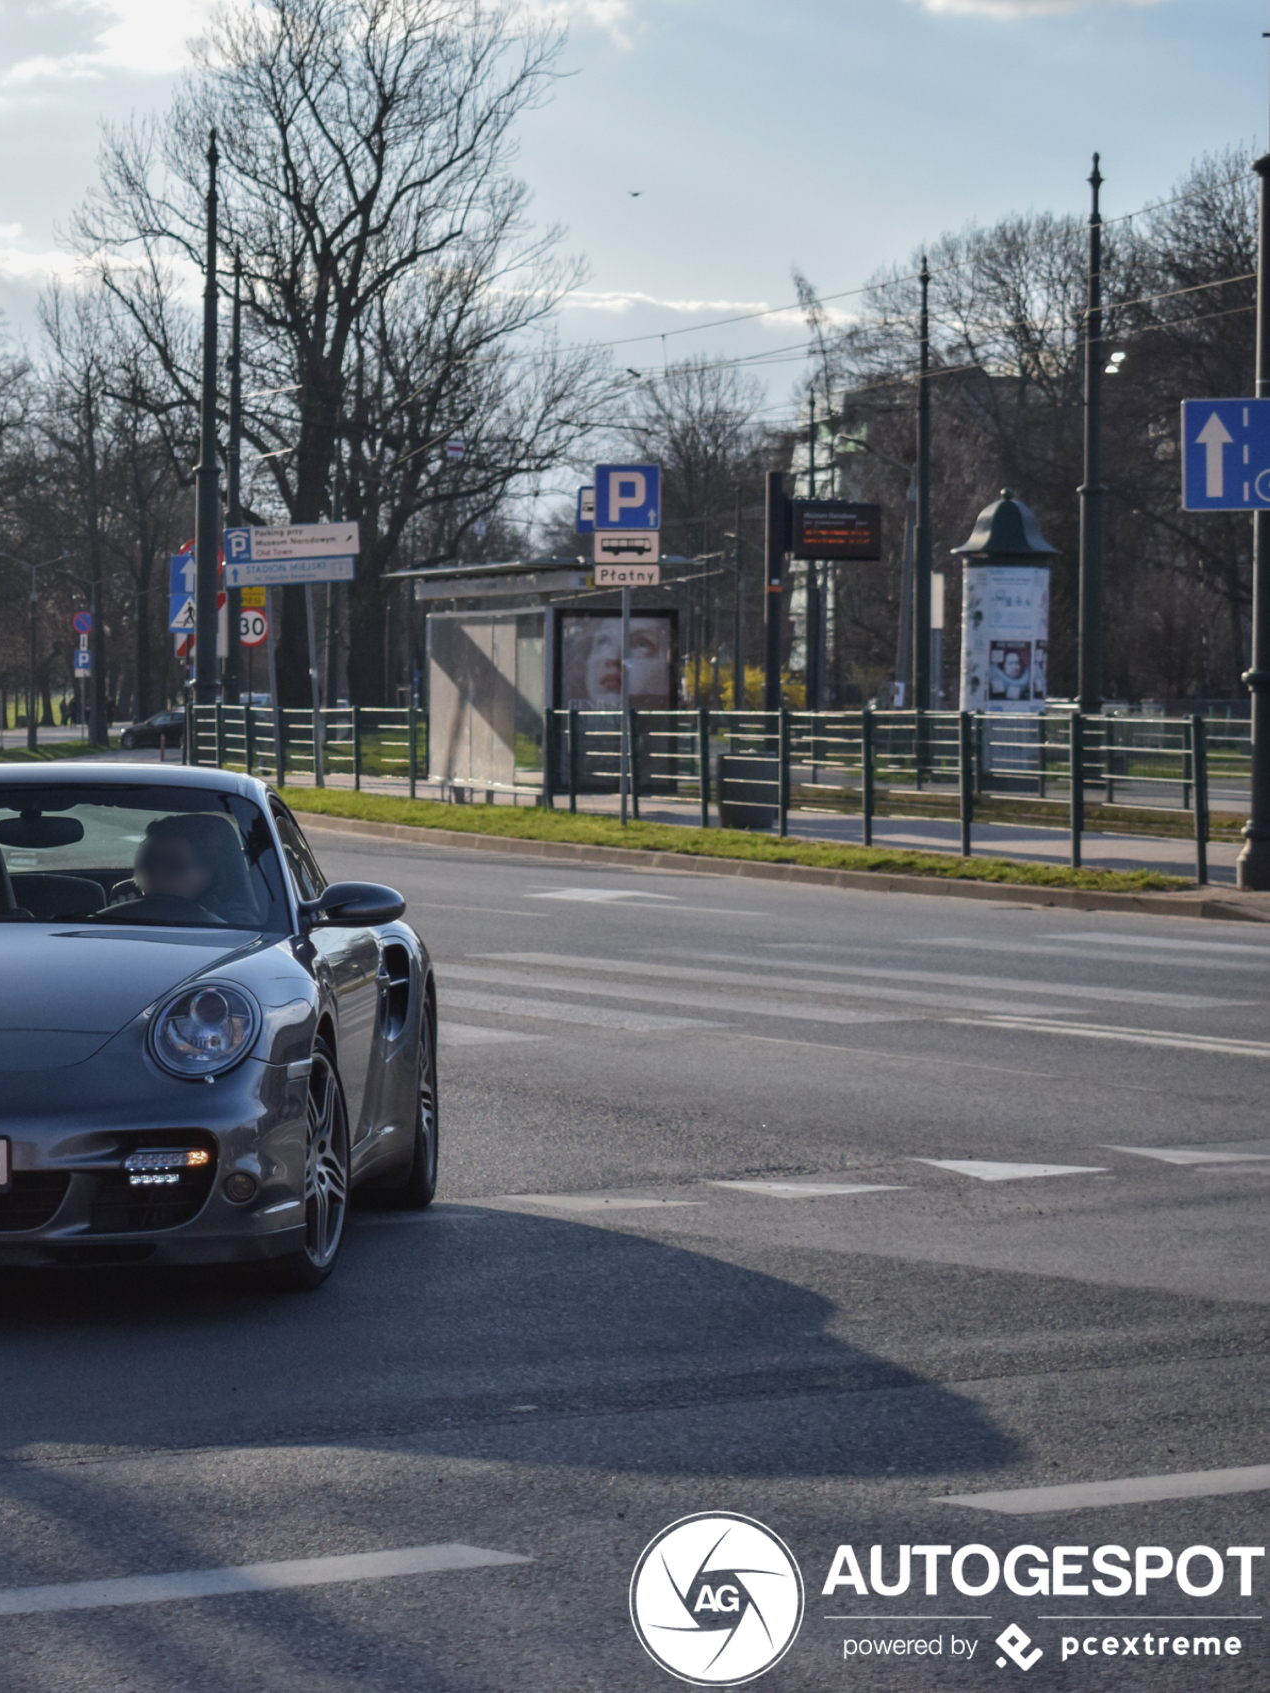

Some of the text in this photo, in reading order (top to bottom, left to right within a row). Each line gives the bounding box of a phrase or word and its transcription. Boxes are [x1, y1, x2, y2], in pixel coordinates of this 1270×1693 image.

[609, 471, 646, 522] P
[255, 530, 284, 538] Parking
[256, 547, 293, 557] Old Town
[246, 562, 325, 574] STADION MIEJSKI
[600, 569, 655, 584] Płatny
[241, 618, 264, 635] 30
